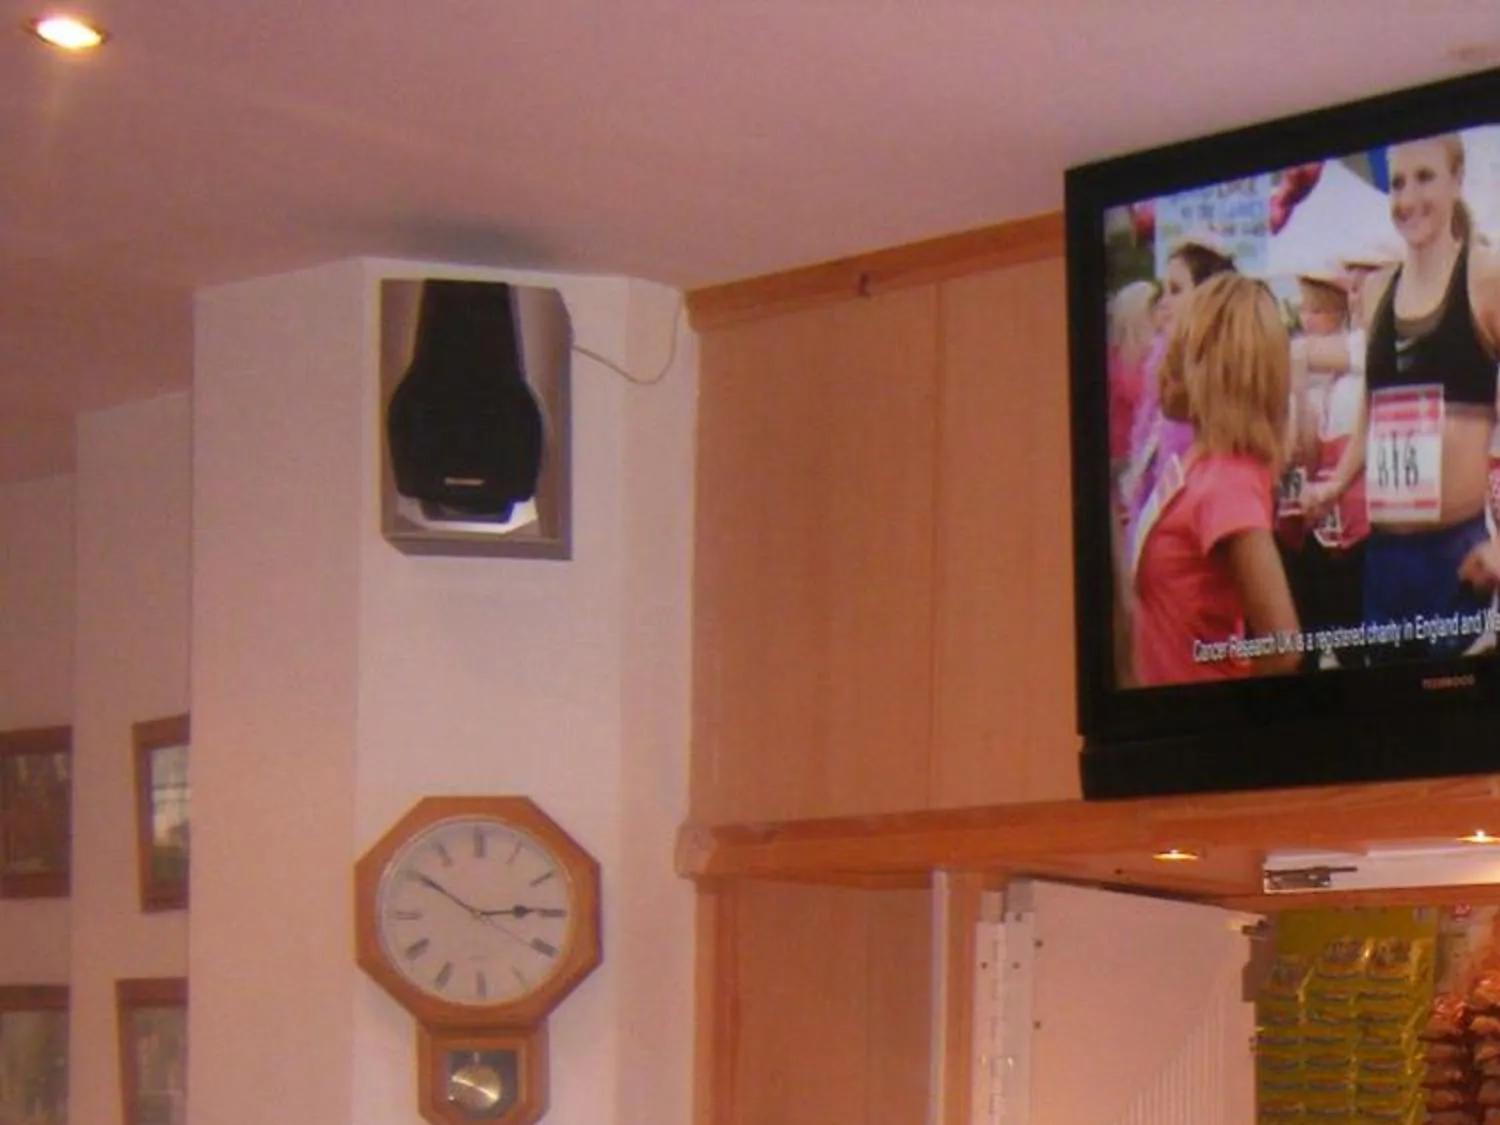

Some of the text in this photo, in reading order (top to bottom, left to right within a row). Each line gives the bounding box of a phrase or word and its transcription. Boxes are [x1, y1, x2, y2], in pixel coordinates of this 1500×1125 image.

[1193, 639, 1228, 662] Cancer
[1229, 633, 1275, 659] Research
[1277, 628, 1297, 654] UK
[1315, 623, 1365, 653] registered
[1367, 617, 1400, 648] charity
[1415, 612, 1458, 645] England
[1460, 609, 1482, 636] and
